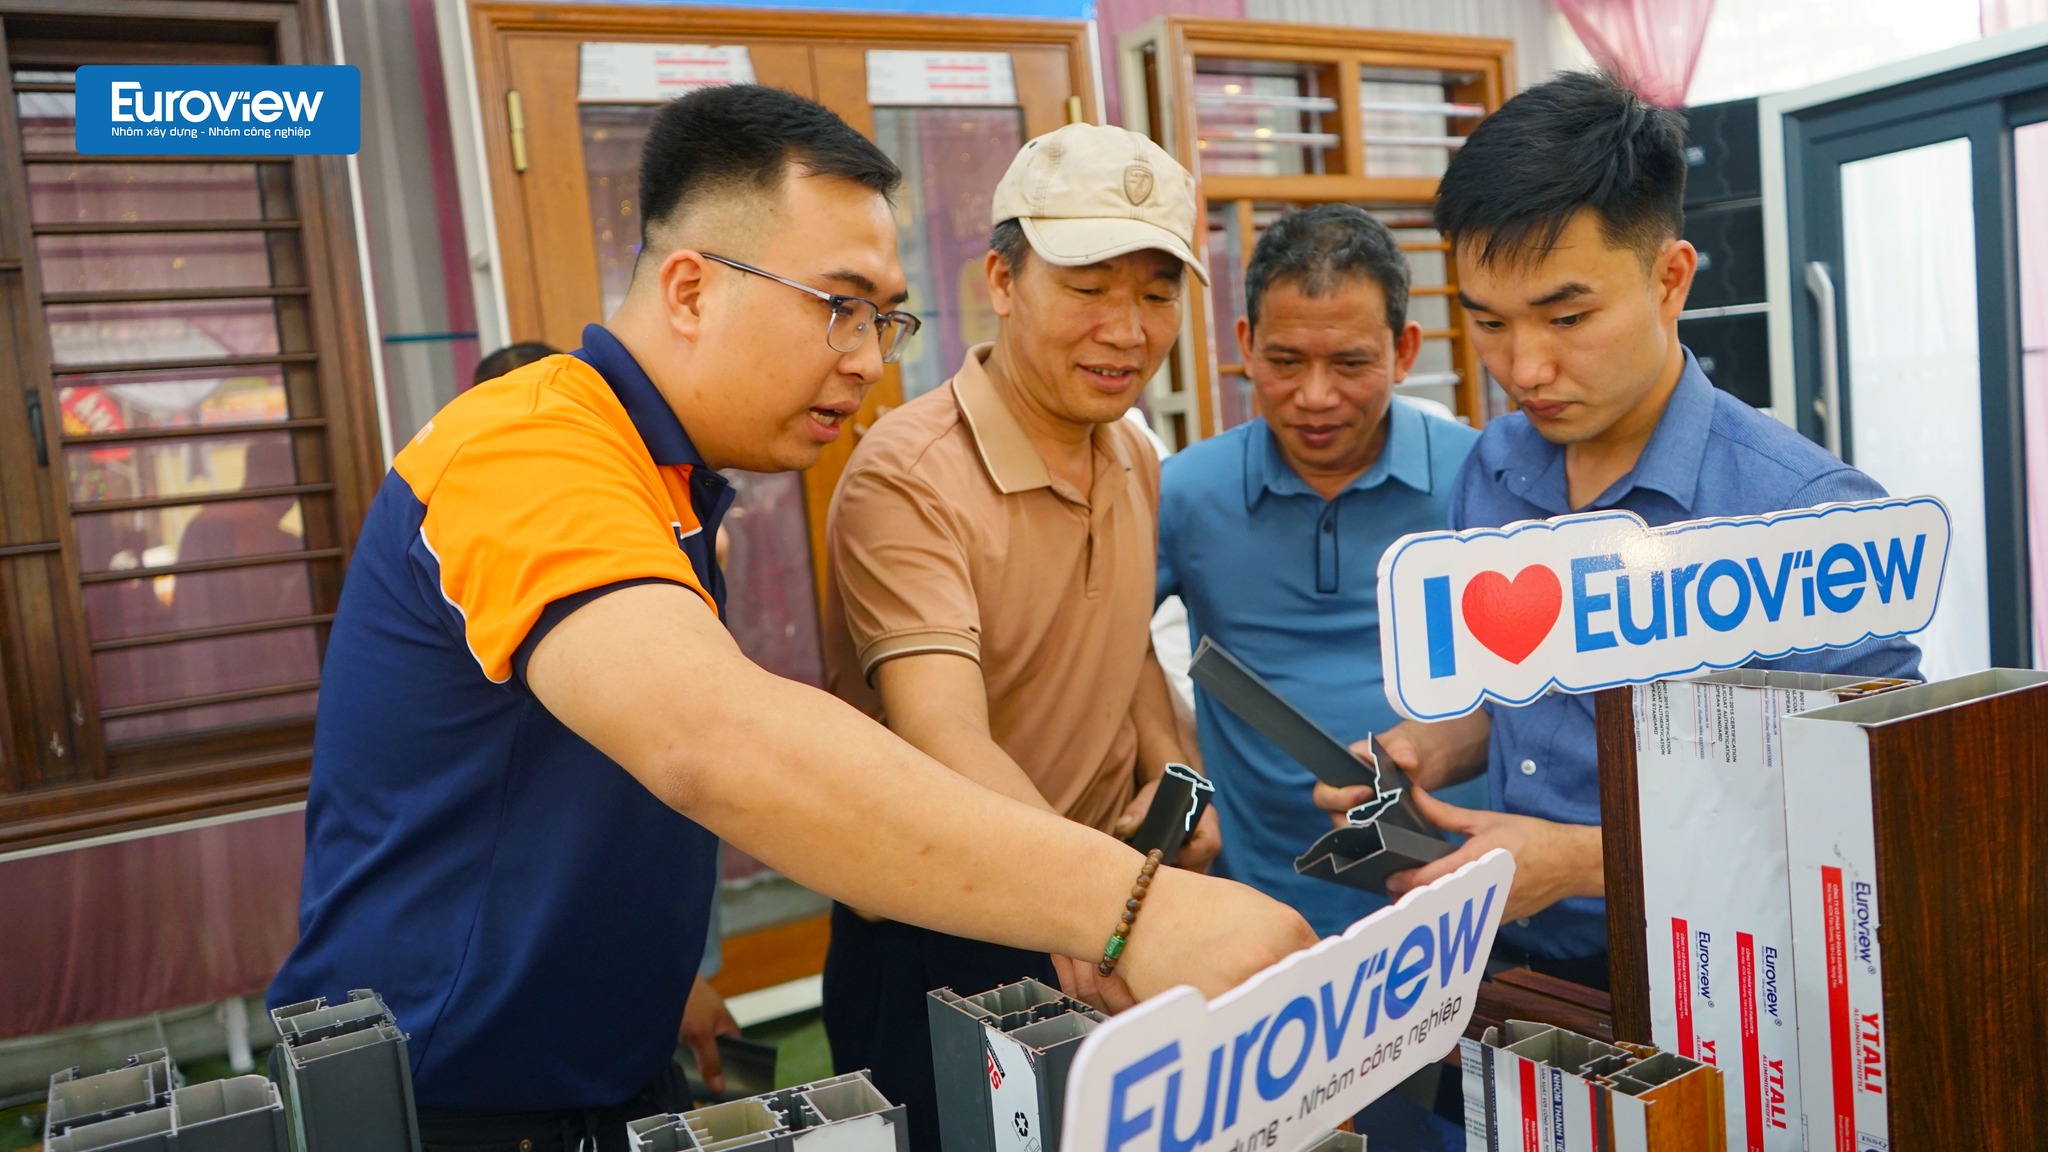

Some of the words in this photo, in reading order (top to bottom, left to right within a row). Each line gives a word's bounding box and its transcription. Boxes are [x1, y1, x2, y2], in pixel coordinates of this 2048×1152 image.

[1423, 575, 1456, 679] I
[1570, 533, 1927, 653] Euroview
[1856, 882, 1872, 964] Euroview
[1699, 931, 1711, 999] Euroview
[1765, 946, 1778, 1017] Euroview
[1299, 1068, 1354, 1120] Nhôm
[1360, 1034, 1404, 1078] công
[1408, 996, 1462, 1046] nghiệp
[1553, 1074, 1562, 1102] NHÔM
[1861, 1012, 1882, 1094] YTALI
[1554, 1104, 1563, 1136] THANH
[1768, 1060, 1787, 1129] YTALI
[1862, 1136, 1887, 1148] ISSQ
